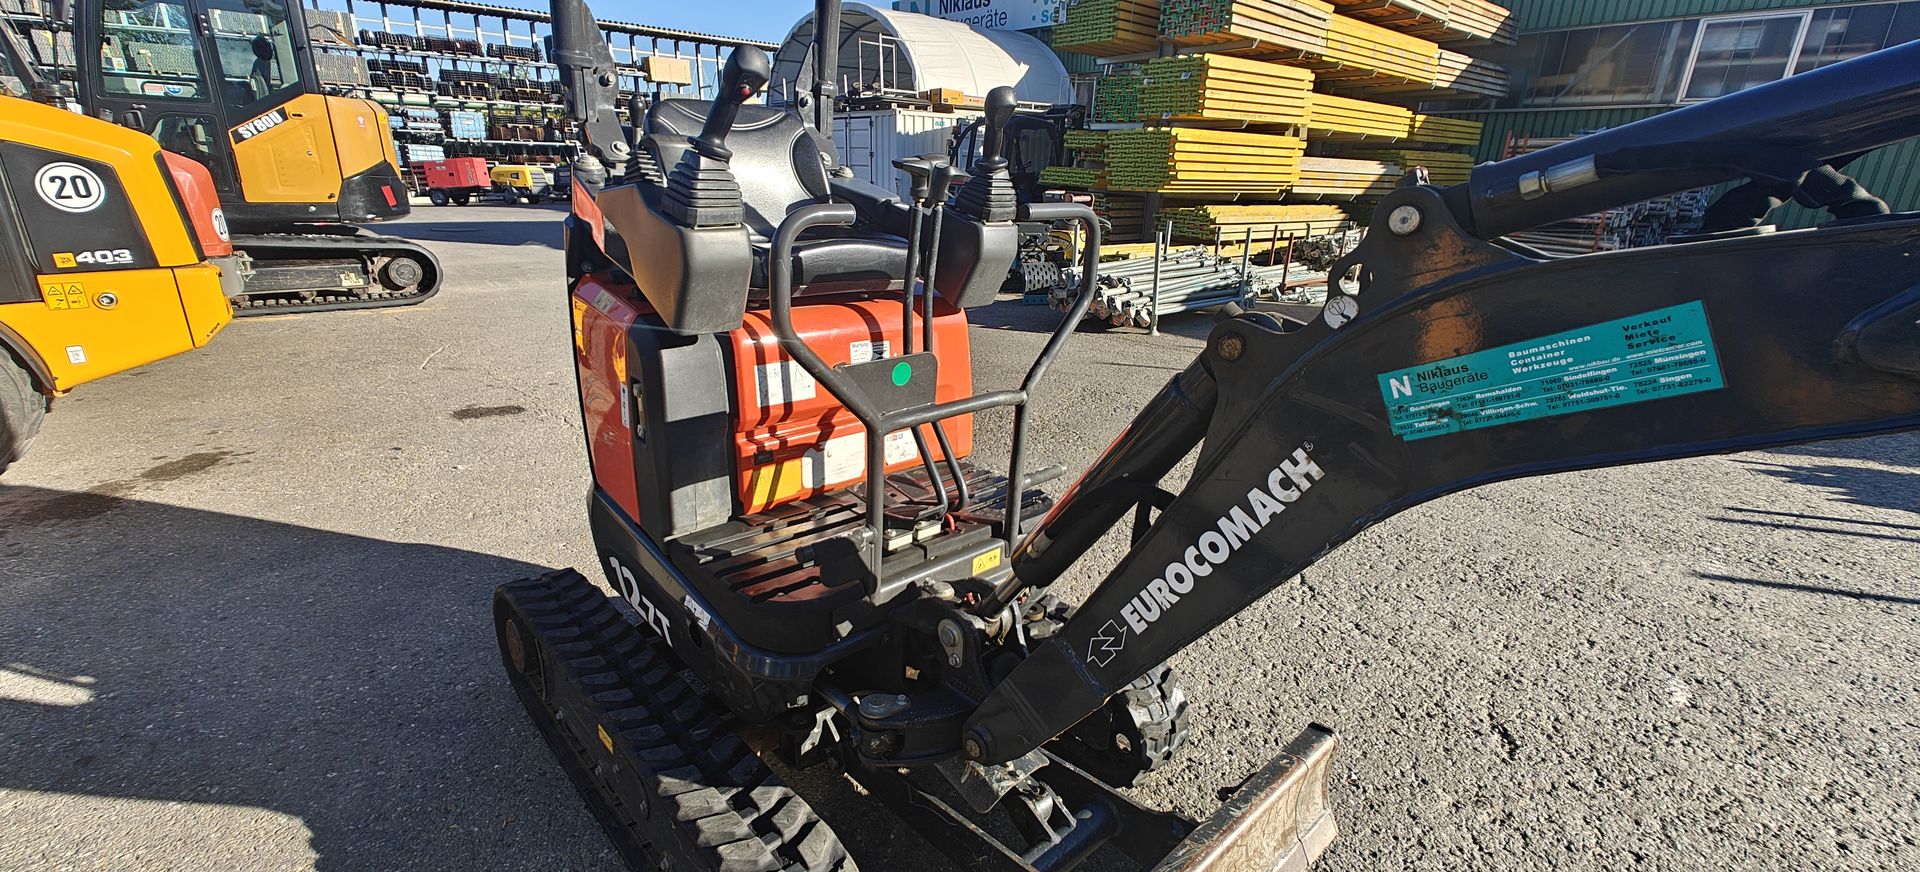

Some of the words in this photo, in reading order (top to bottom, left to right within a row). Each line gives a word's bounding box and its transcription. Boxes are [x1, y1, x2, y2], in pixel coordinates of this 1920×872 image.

[238, 108, 284, 140] SY80U
[49, 174, 93, 200] 20
[214, 213, 227, 236] 20
[75, 248, 133, 264] 403
[1621, 314, 1672, 332] Verkauf
[1624, 328, 1660, 341] Miete
[1627, 334, 1676, 350] Service
[1508, 334, 1591, 359] Baumaschinen
[1510, 349, 1566, 366] Container
[1512, 356, 1574, 375] Werkzeuge
[1654, 349, 1707, 364] Münsingen
[1416, 364, 1470, 382] Niklaus
[1419, 370, 1489, 393] Baugeräte
[1563, 366, 1618, 382] Sindelfingen
[1658, 372, 1693, 384] Singen
[1389, 374, 1413, 399] N
[1120, 447, 1326, 636] EUROCOMACH
